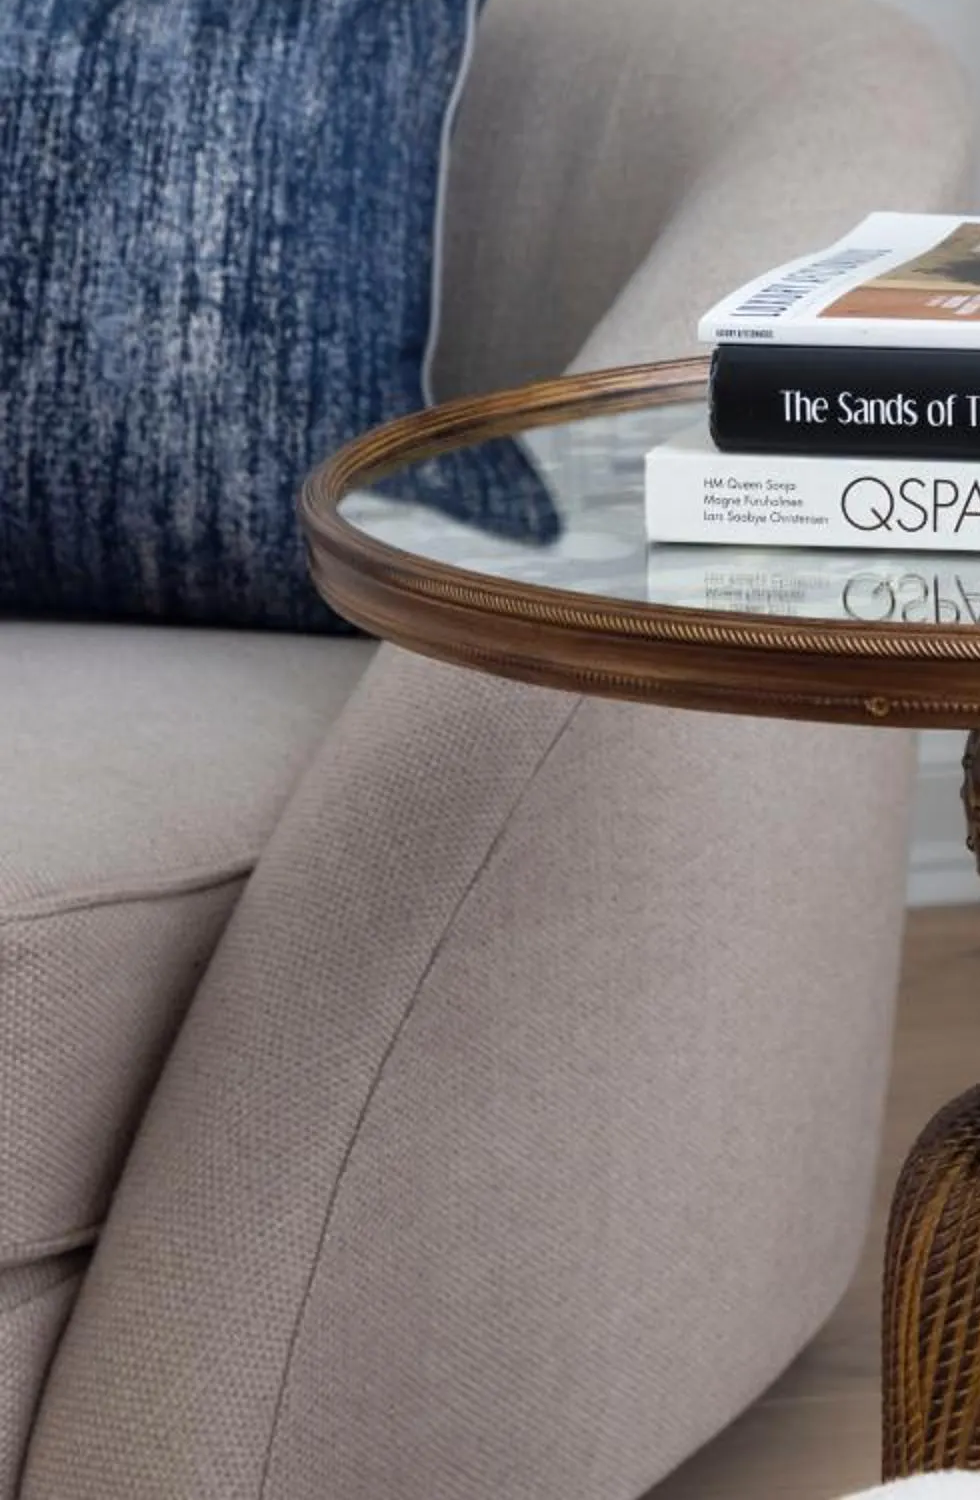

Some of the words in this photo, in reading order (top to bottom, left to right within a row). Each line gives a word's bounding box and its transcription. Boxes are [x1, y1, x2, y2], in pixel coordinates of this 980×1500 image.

[780, 389, 829, 423] The
[837, 391, 918, 426] Sands
[927, 393, 957, 427] of
[703, 477, 723, 489] HM
[727, 476, 763, 490] Queen
[765, 478, 797, 494] Sonja
[703, 494, 741, 509] Magne
[703, 509, 724, 521] Lars
[727, 509, 767, 526] Saabye
[769, 511, 829, 525] Christensen
